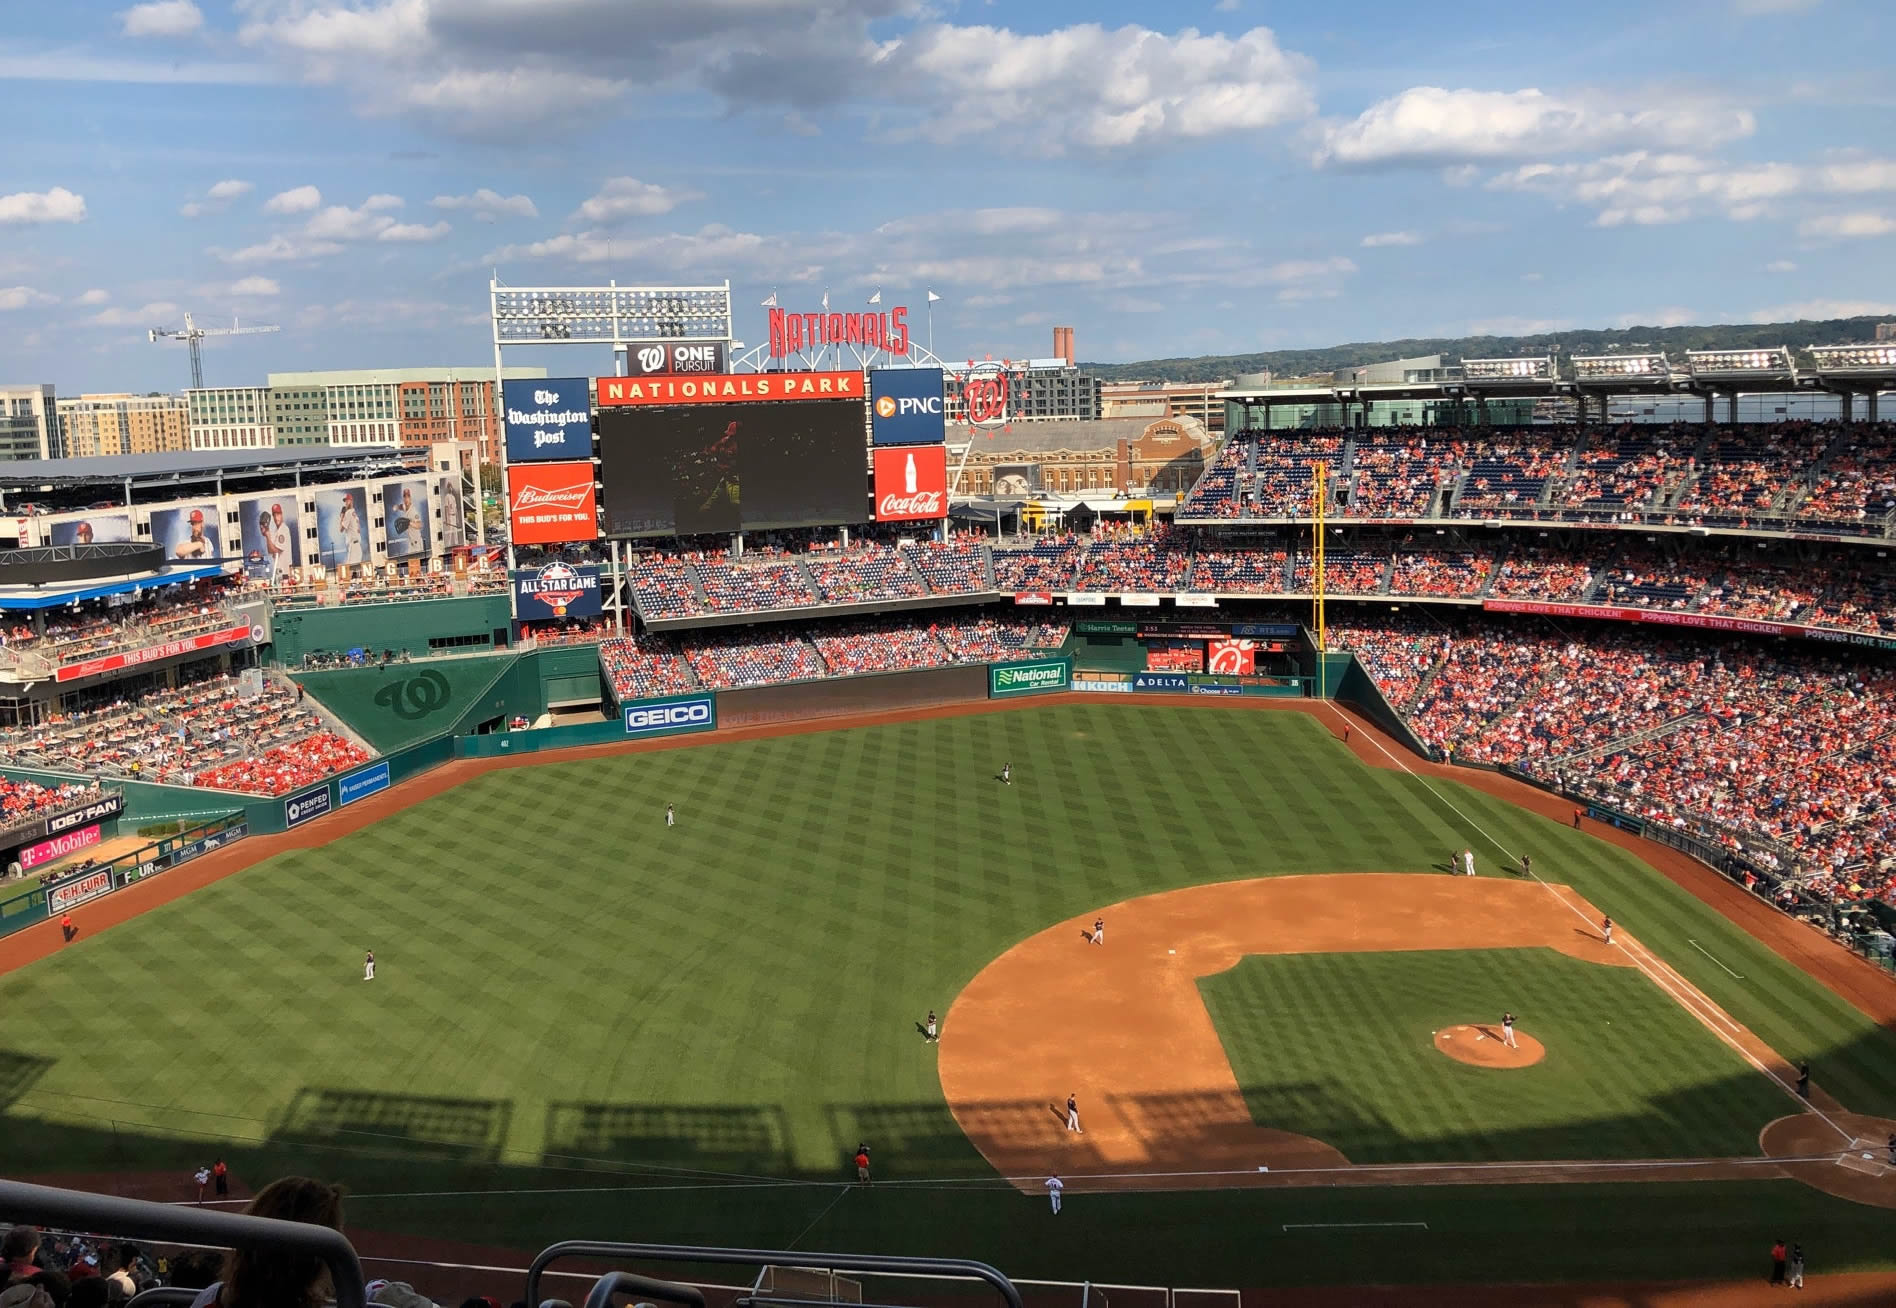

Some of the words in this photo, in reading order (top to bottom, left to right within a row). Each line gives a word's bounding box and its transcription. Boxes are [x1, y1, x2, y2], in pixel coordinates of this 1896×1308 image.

[768, 306, 909, 358] NATIONALS
[674, 346, 715, 362] ONE
[674, 360, 715, 373] PURSUIT
[608, 379, 770, 400] NATIONALS
[783, 376, 852, 395] PARK
[534, 389, 560, 407] The
[899, 396, 942, 415] PNC
[507, 407, 589, 428] Washington
[533, 429, 566, 449] Post
[517, 489, 588, 504] Budweiser
[518, 515, 535, 525] THIS
[536, 514, 558, 524] BUD'S
[559, 513, 573, 522] FOR
[574, 512, 591, 521] YOU.
[293, 561, 399, 582] SWING
[432, 556, 489, 572] BIG
[520, 580, 540, 594] ALL
[541, 578, 568, 592] STAR
[569, 576, 597, 590] GAME
[1527, 604, 1551, 614] LOVE
[1552, 606, 1577, 616] THAT
[1087, 624, 1111, 632] Harris
[1112, 624, 1136, 632] Teeter
[1681, 616, 1707, 627] LOVE
[1708, 618, 1734, 630] THAT
[1736, 621, 1782, 635] CHICKEN!
[1849, 635, 1876, 647] LOVE
[122, 651, 142, 665] THIS
[141, 646, 166, 661] BUD'S
[165, 641, 180, 655] FOR
[180, 637, 197, 651] YOU.
[1012, 666, 1062, 683] National
[1147, 678, 1186, 687] DELTA
[1086, 681, 1130, 692] KOCH
[628, 704, 709, 728] GEICO
[85, 799, 117, 819] FAN
[300, 793, 328, 811] PENFED
[225, 827, 242, 839] MGM
[180, 845, 198, 858] MGM
